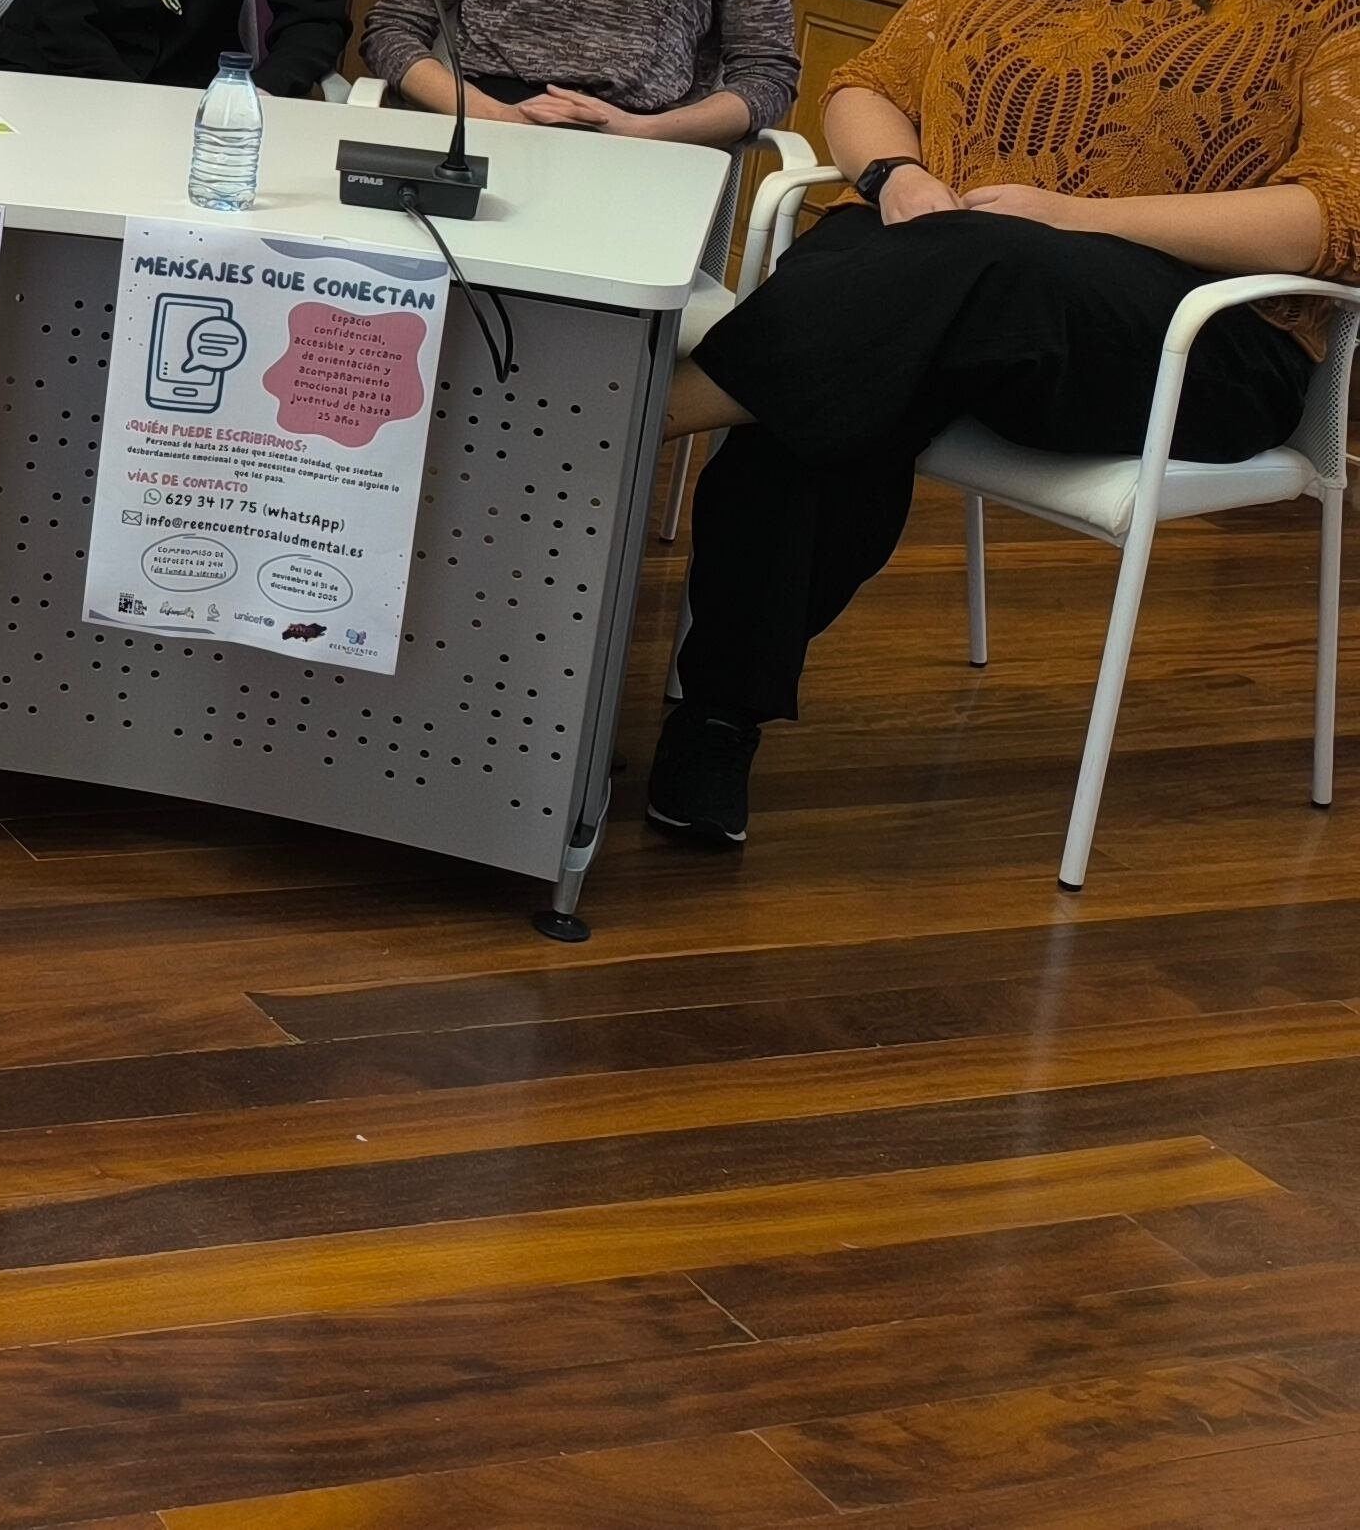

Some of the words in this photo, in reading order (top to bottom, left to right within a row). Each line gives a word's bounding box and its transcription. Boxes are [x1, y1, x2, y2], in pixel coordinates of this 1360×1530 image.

[134, 255, 254, 284] MENSAJES
[261, 268, 304, 291] QUE
[313, 276, 434, 310] CONECTAN
[331, 313, 371, 327] Espacio
[313, 326, 385, 345] confidencial,
[293, 336, 344, 351] accesible
[348, 347, 355, 355] y
[359, 347, 402, 360] cercano
[301, 350, 314, 360] de
[317, 355, 379, 372] orientación
[384, 367, 390, 375] y
[298, 365, 389, 387] acompañamiento
[293, 379, 347, 395] emocional
[352, 390, 376, 400] para
[380, 392, 391, 402] la
[290, 393, 339, 408] juventud
[342, 401, 355, 411] de
[359, 403, 390, 416] hasta
[317, 411, 330, 421] 25
[334, 414, 359, 426] años
[171, 423, 212, 439] PUEDE
[127, 467, 158, 484] VÍAS
[161, 473, 178, 486] DE
[182, 476, 248, 493] CONTACTO
[165, 493, 192, 506] 629
[196, 495, 215, 508] 34
[220, 497, 234, 510] 17
[239, 500, 256, 513] 75
[145, 515, 363, 558] info@reencuentrosaludmental.es
